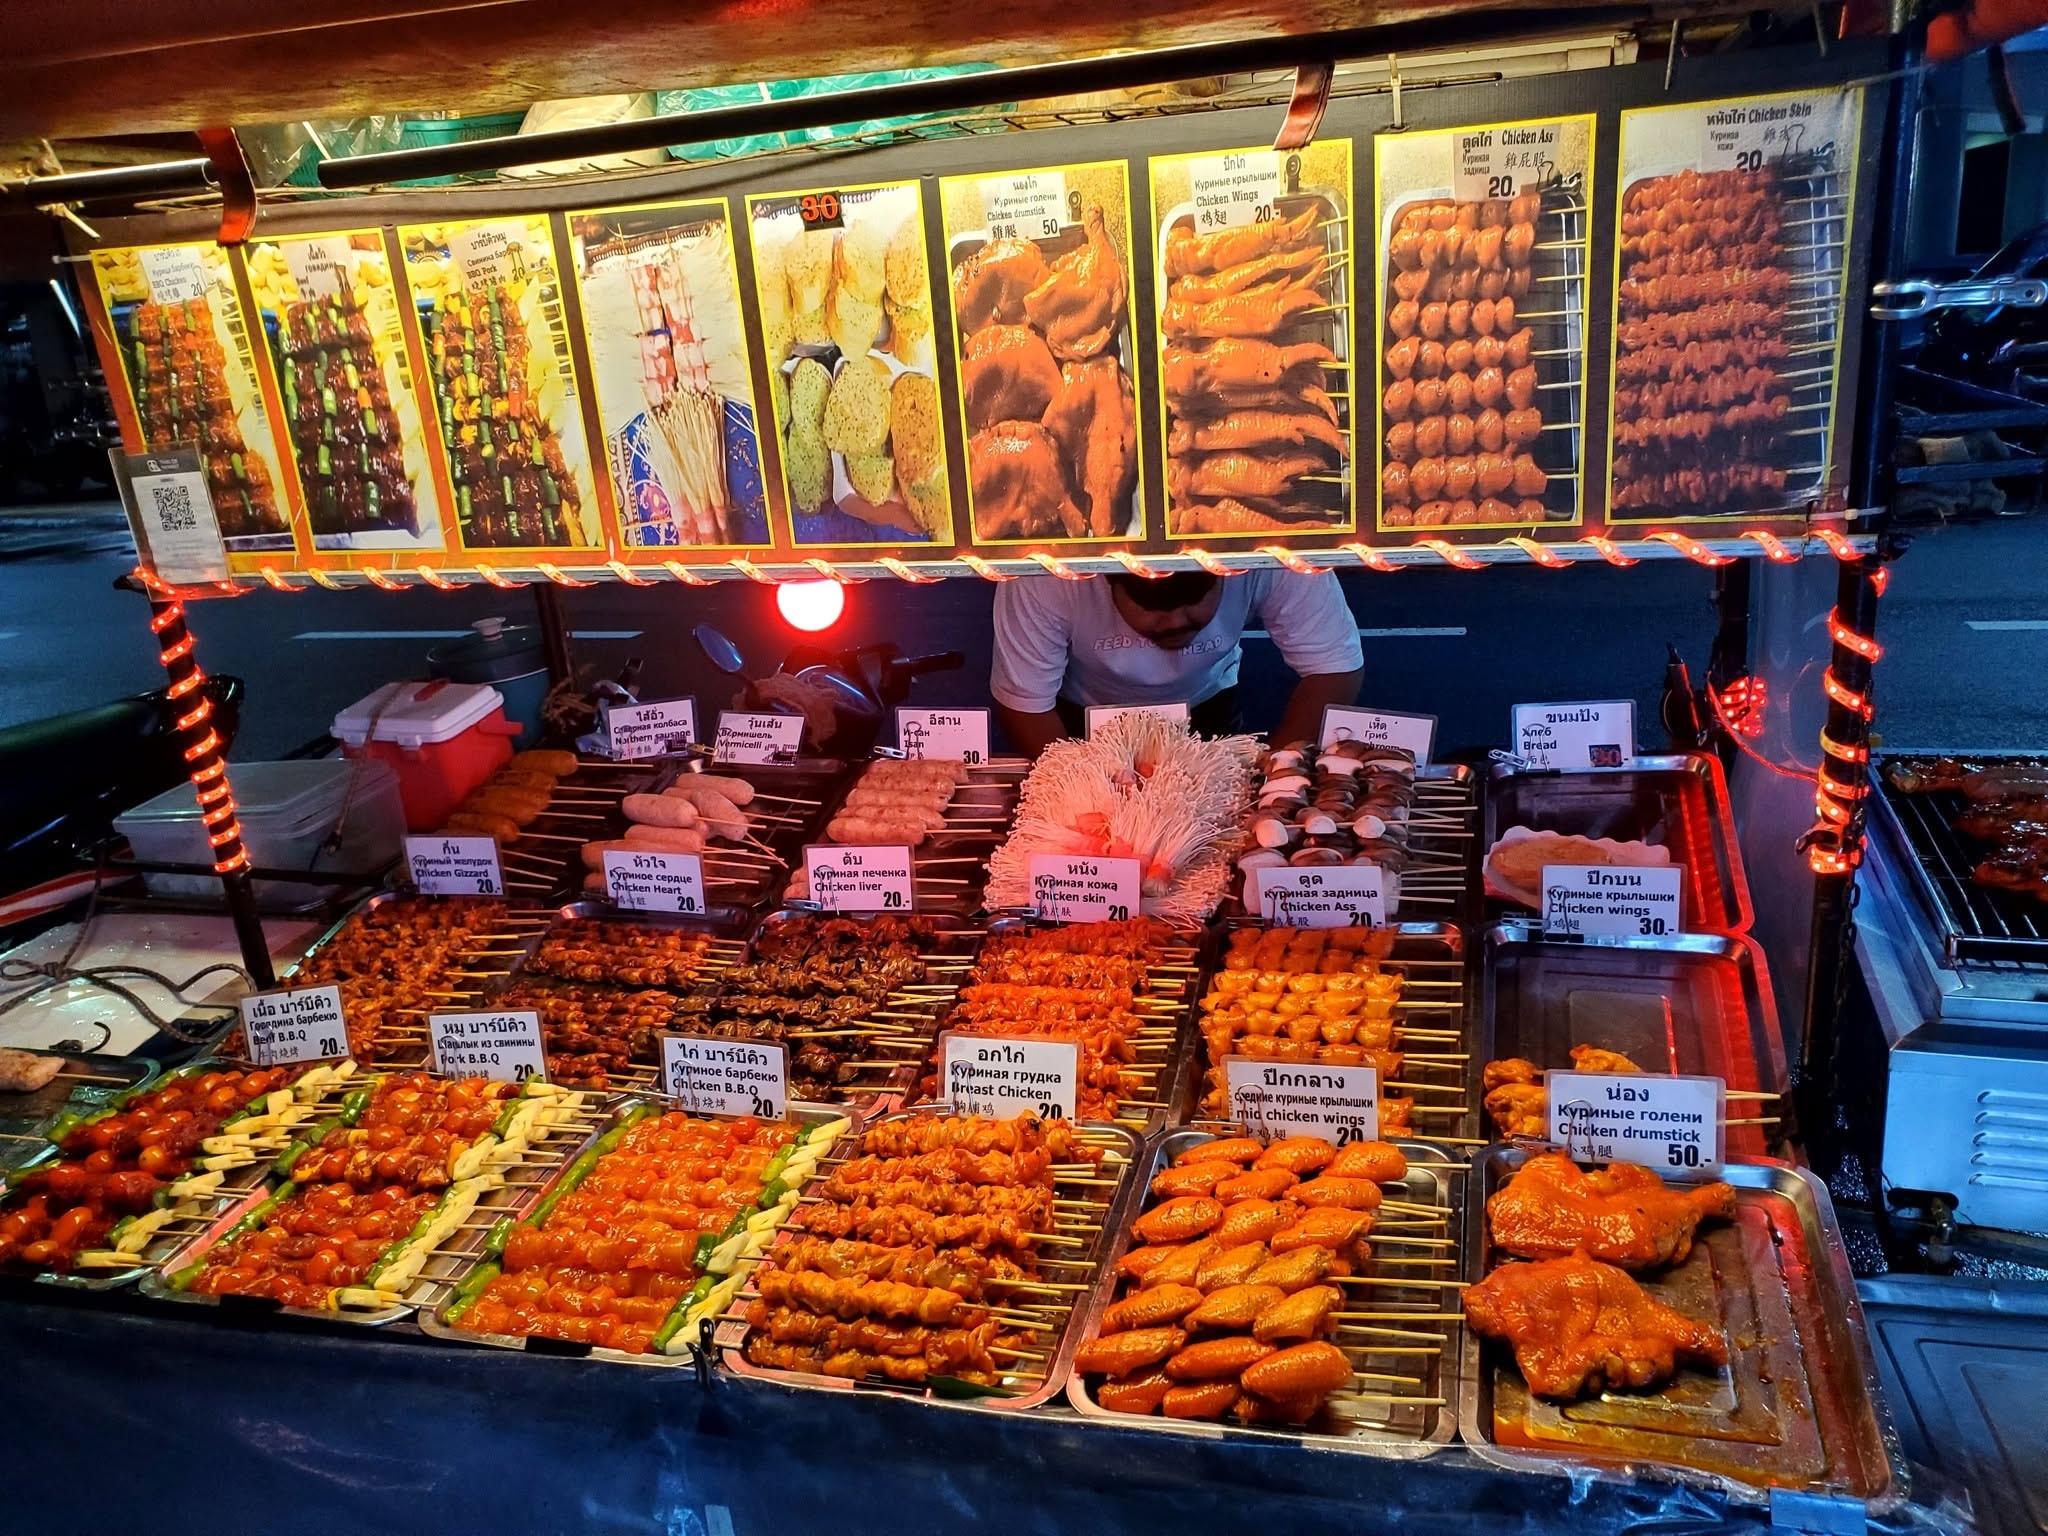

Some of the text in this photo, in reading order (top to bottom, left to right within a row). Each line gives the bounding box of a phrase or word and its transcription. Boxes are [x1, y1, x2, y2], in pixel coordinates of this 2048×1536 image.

[1749, 103, 1812, 123] Chicken Skin
[1502, 128, 1554, 146] Chicken Ass
[1462, 153, 1490, 166] Куриная
[1464, 166, 1490, 176] задница
[1195, 171, 1277, 192] Куриные крылышки
[994, 193, 1057, 208] Куриные голени
[1196, 190, 1259, 208] Chicken Wings
[802, 194, 838, 220] 30
[987, 206, 1046, 221] Chicken drumstick
[1043, 218, 1058, 235] 50
[482, 265, 497, 275] Pork
[1093, 634, 1132, 651] FEED
[1182, 635, 1223, 656] HEAD
[929, 714, 961, 725] อีสาน
[1546, 709, 1600, 723] ขนมปัง
[654, 719, 687, 729] колбаса
[1364, 731, 1388, 740] Гриб
[719, 740, 762, 749] Vermicelli
[1524, 740, 1557, 750] Bread
[963, 750, 986, 764] 30.-
[454, 859, 492, 867] желудок
[416, 869, 489, 877] Chicken Gizzard
[656, 874, 692, 883] сердце
[813, 869, 906, 880] Куриная печенка
[1587, 870, 1642, 886] ปีกบน
[477, 879, 501, 893] 20.-
[612, 882, 682, 894] Chicken Heart
[815, 882, 882, 891] Chicken liver
[1035, 876, 1118, 892] Куриная кожа
[883, 891, 909, 907] 20.-
[1035, 891, 1106, 903] Chicken skin
[1322, 890, 1378, 899] задница
[1549, 889, 1675, 902] Куриные крылышки
[677, 896, 703, 912] 20.-
[1280, 902, 1356, 911] Chicken Ass
[1550, 903, 1650, 917] Chicken wings
[1640, 918, 1674, 935] 30.-
[280, 995, 331, 1014] บาร์บีคิว
[296, 1012, 337, 1026] барбекю
[443, 1017, 527, 1037] หมู บาร์บีคิว
[278, 1030, 306, 1042] B.B.Q
[495, 1038, 535, 1048] свинины
[320, 1038, 344, 1056] 20.-
[678, 1043, 767, 1065] ไก่ บาร์บีคิว
[978, 1045, 1025, 1063] อกไก่
[469, 1053, 500, 1065] B.B.Q
[671, 1063, 778, 1082] Куриное барбекю
[951, 1064, 1061, 1084] Куриная грудка
[1263, 1068, 1345, 1089] ปีกกลาง
[725, 1083, 758, 1097] B.B.Q
[952, 1082, 1052, 1100] Breast Chicken
[1606, 1082, 1650, 1102] น่อง
[752, 1097, 782, 1119] 20.-
[1276, 1093, 1317, 1106] куриные
[1320, 1096, 1373, 1108] крылышки
[1266, 1109, 1319, 1123] chicken
[1324, 1112, 1365, 1127] wings
[1558, 1104, 1702, 1123] Куриные голени
[1559, 1123, 1701, 1142] Chicken drumstick
[1668, 1144, 1712, 1168] 50.-
